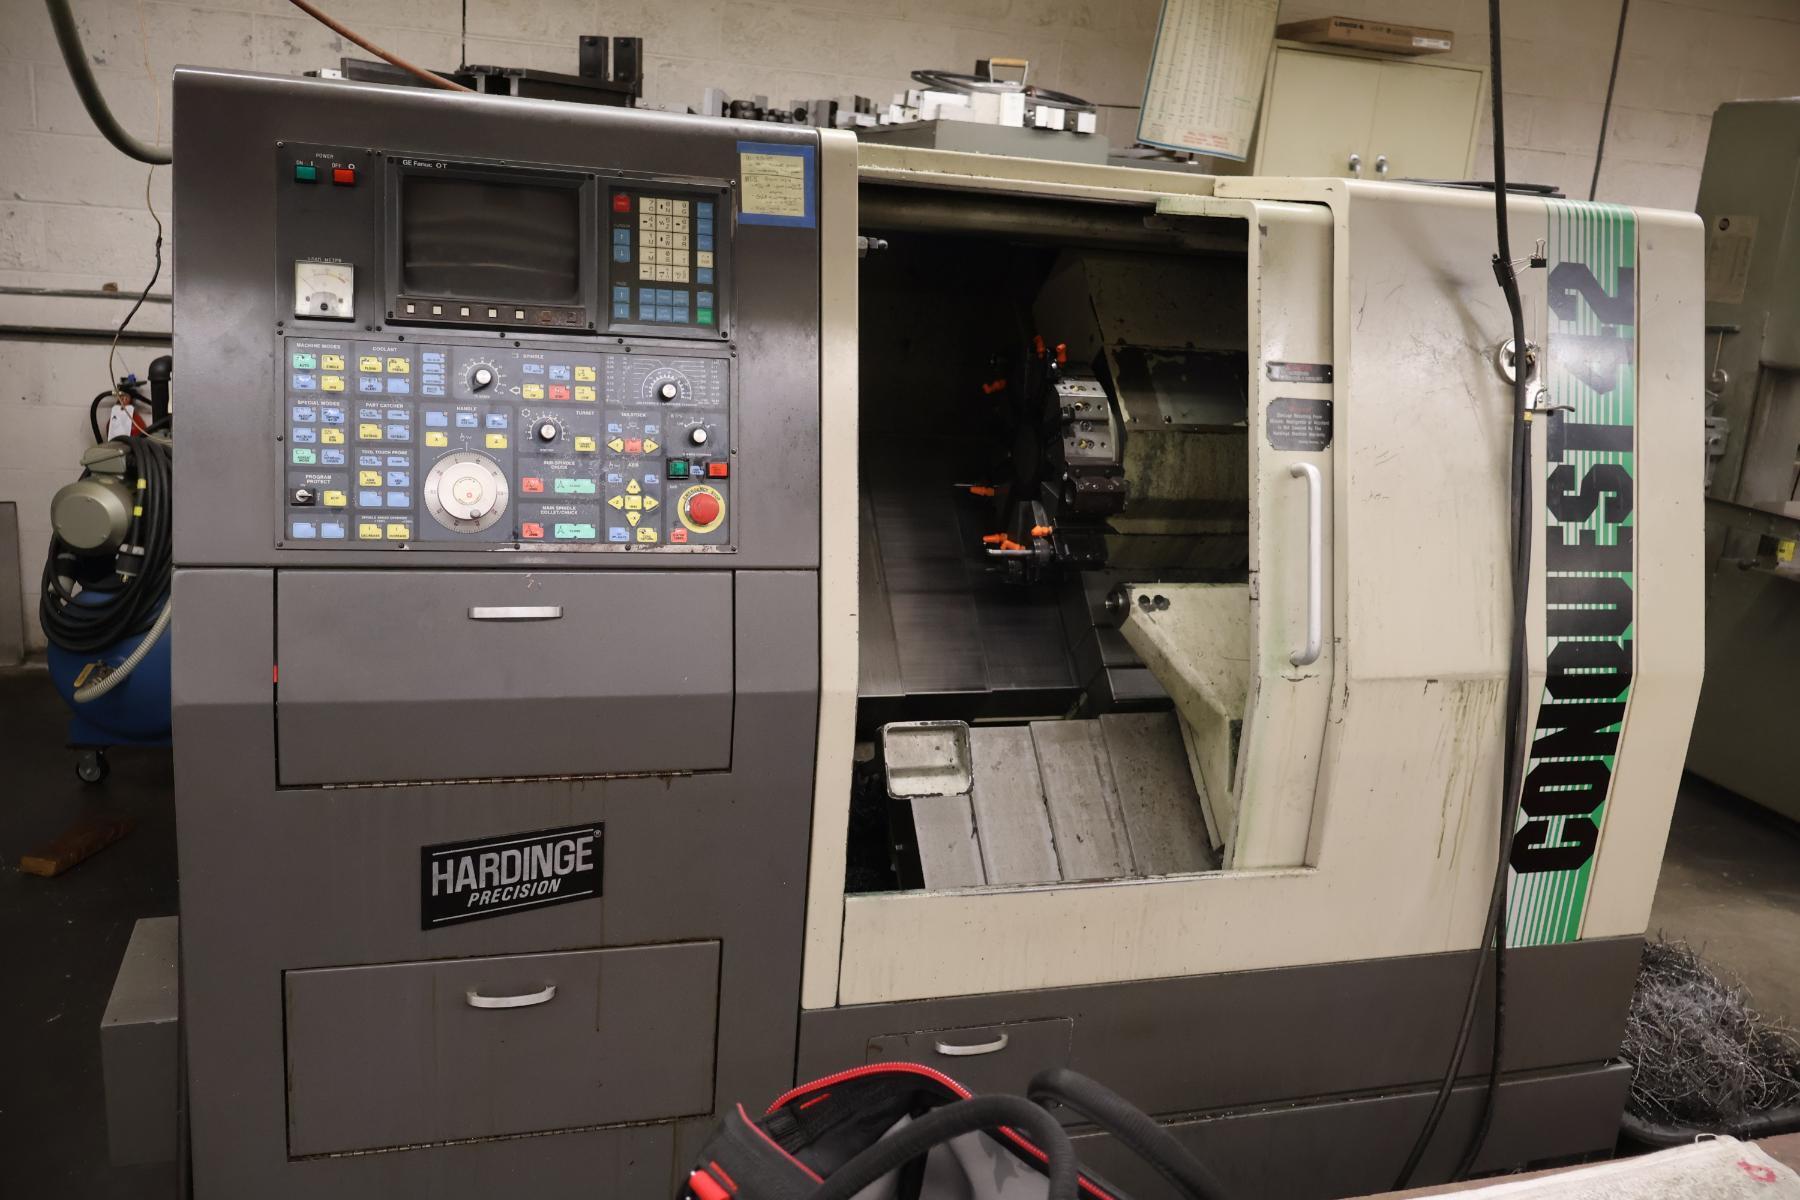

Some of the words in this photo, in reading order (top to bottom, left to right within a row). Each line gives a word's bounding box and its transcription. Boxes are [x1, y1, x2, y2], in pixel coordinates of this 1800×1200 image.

[413, 160, 433, 168] Fanuc
[1546, 261, 1635, 395] 42
[682, 486, 709, 500] EMERGENCY
[1509, 409, 1634, 874] CONQUEST
[431, 835, 594, 897] HARDINGE
[466, 877, 562, 908] PRECISION
